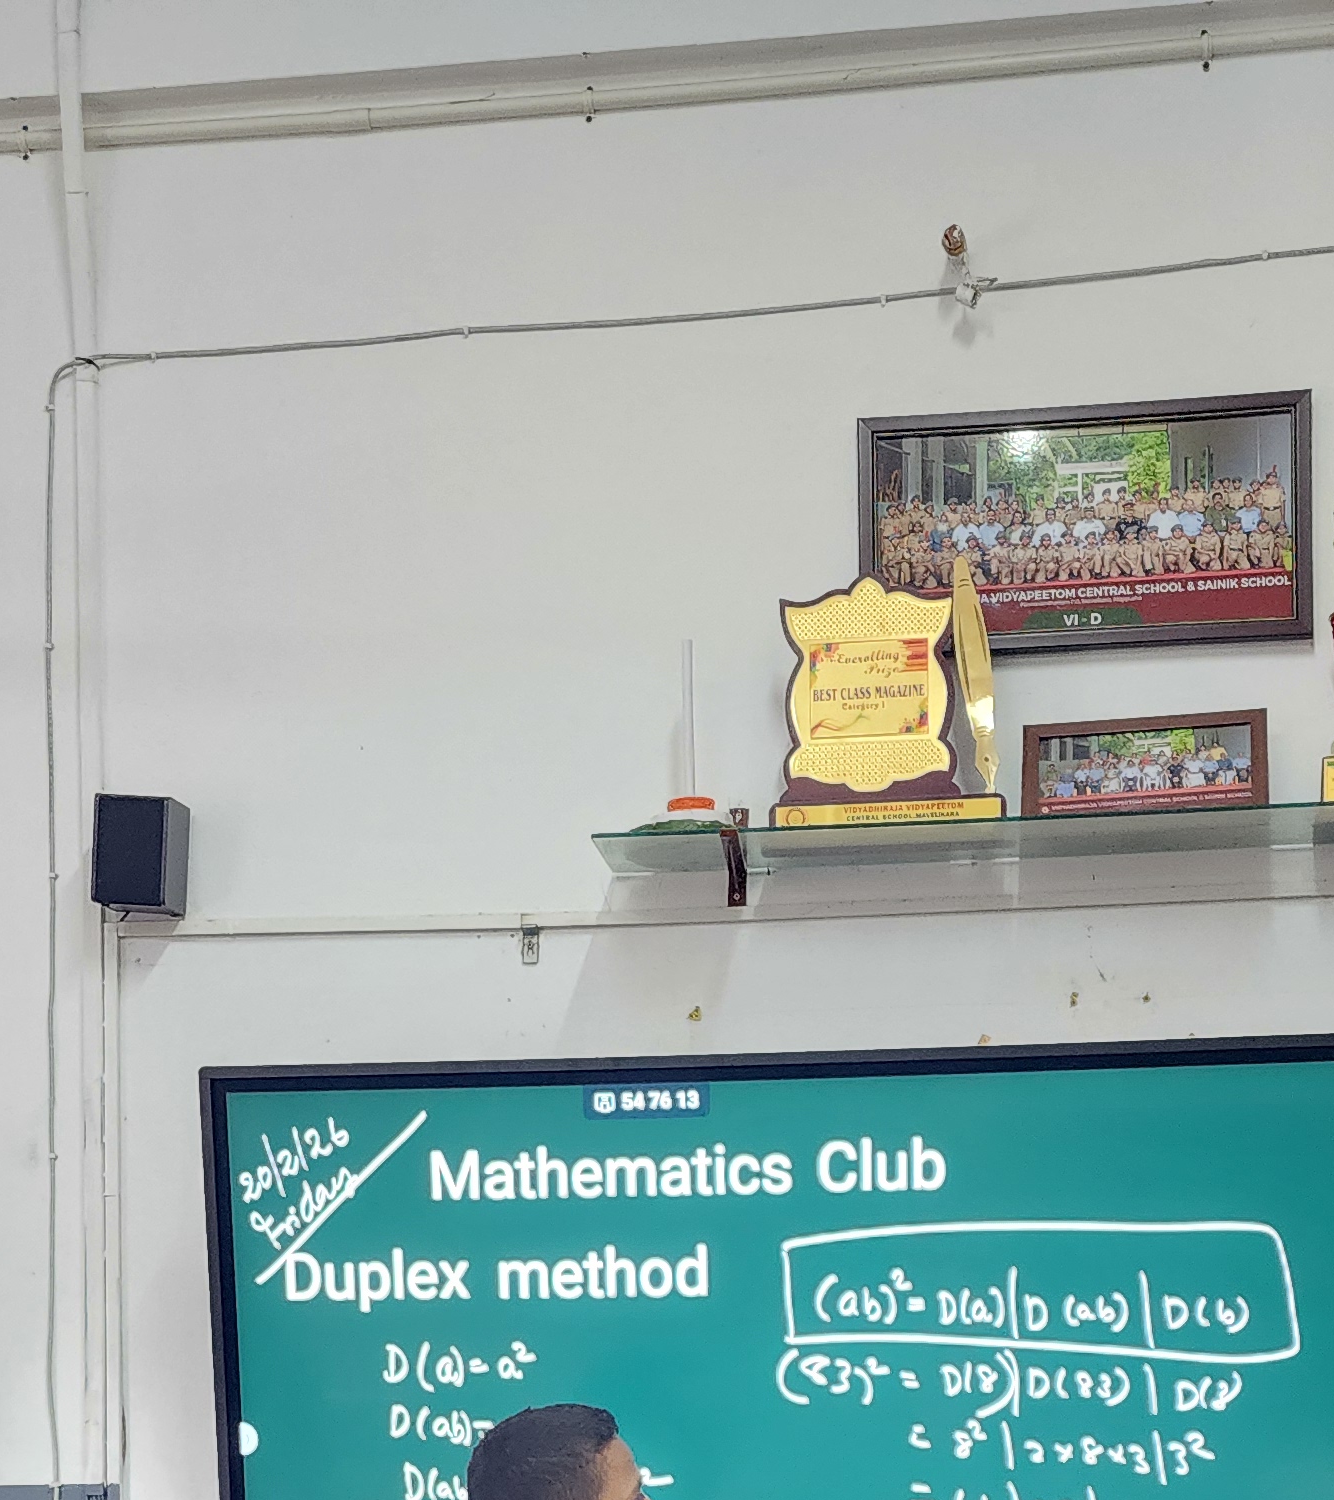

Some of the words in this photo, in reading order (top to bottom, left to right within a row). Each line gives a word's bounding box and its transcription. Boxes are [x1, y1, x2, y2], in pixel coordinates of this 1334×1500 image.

[990, 587, 1076, 604] VIDYAPEETOM
[1078, 584, 1134, 598] CENTRAL
[1136, 581, 1186, 593] SCHOOL
[1187, 579, 1195, 591] &
[1198, 577, 1239, 590] SAINIK
[1241, 574, 1292, 588] SCHOOL
[1063, 614, 1079, 626] VI
[1091, 612, 1102, 625] D
[813, 688, 837, 702] BEST
[840, 686, 871, 700] CLASS
[874, 683, 925, 699] MAGAZINE
[621, 1090, 645, 1111] 54
[647, 1089, 672, 1110] 76
[675, 1089, 700, 1110] 13
[429, 1145, 793, 1201] Mathematics
[817, 1136, 947, 1194] Club
[285, 1247, 470, 1313] Duplex
[498, 1242, 709, 1300] method
